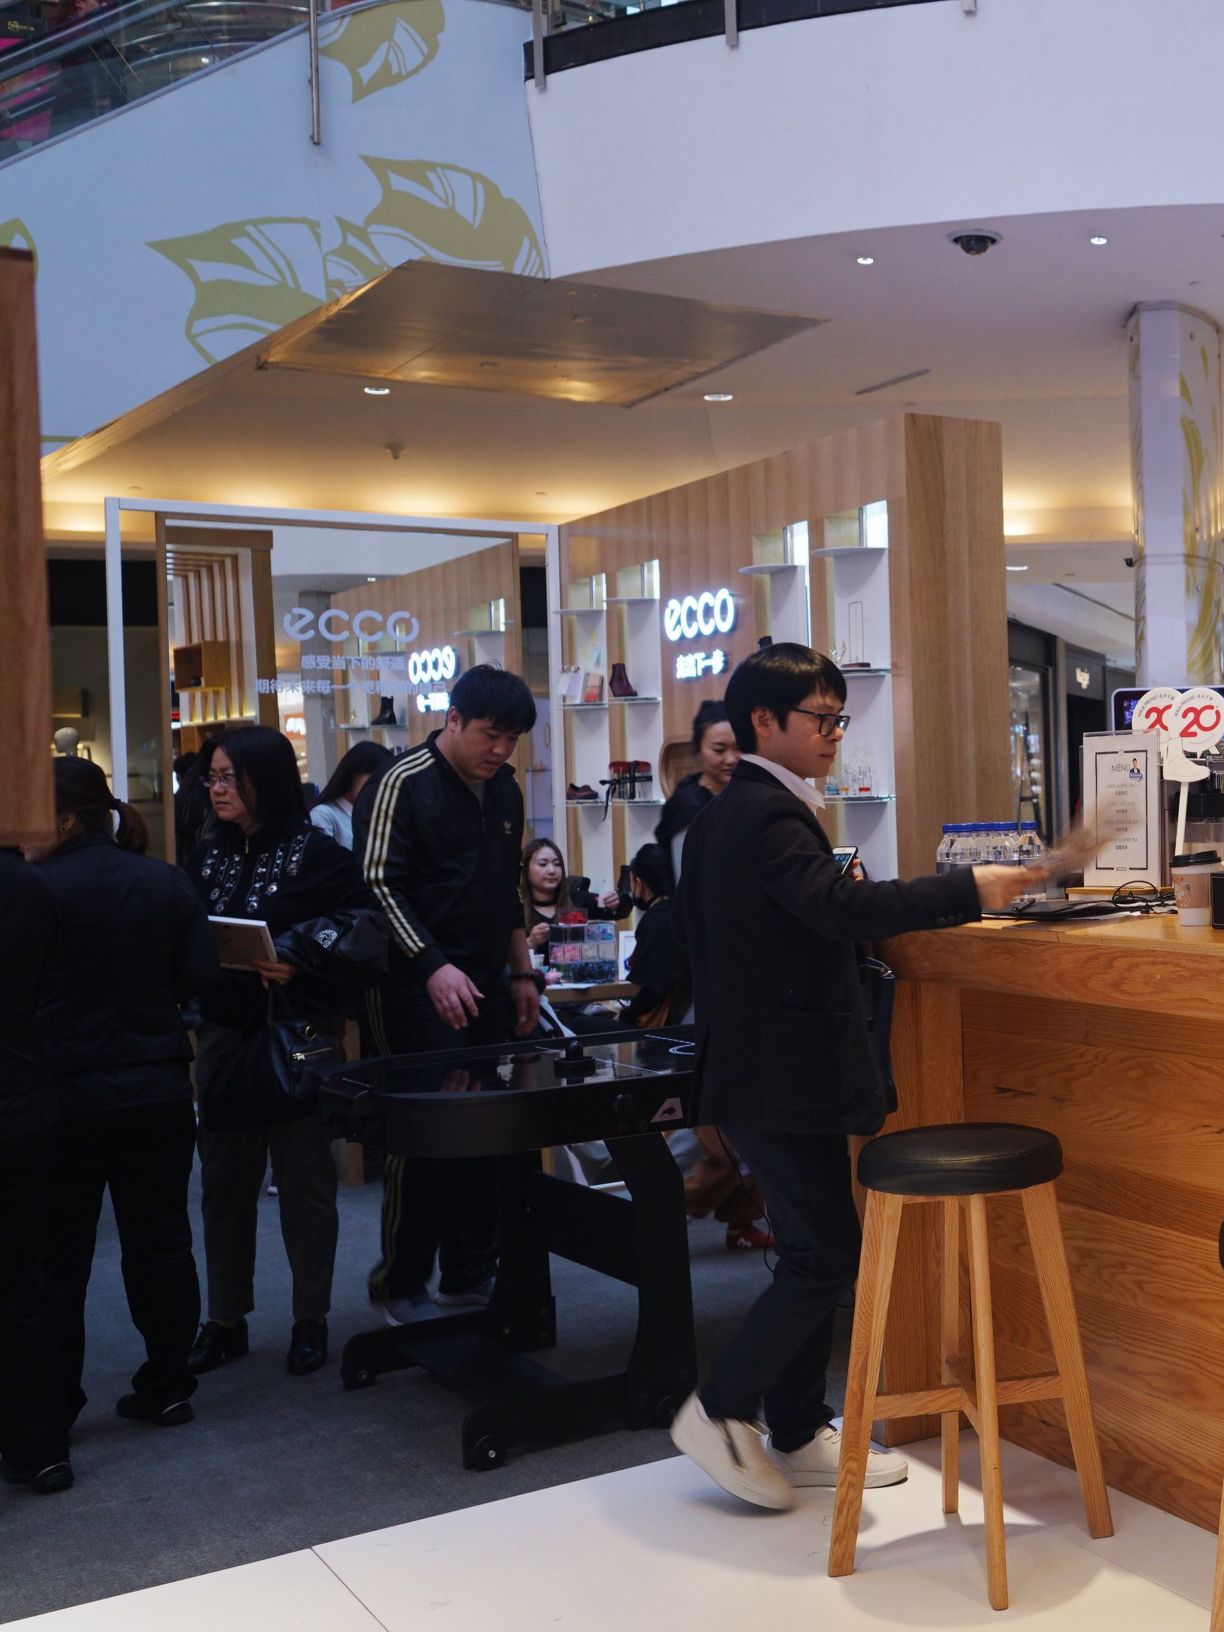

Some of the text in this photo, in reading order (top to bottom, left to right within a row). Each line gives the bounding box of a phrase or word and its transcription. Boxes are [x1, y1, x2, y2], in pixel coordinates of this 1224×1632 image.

[283, 607, 420, 643] ecco
[664, 588, 735, 641] ecco
[1179, 704, 1221, 738] 20
[1111, 763, 1131, 773] MENU
